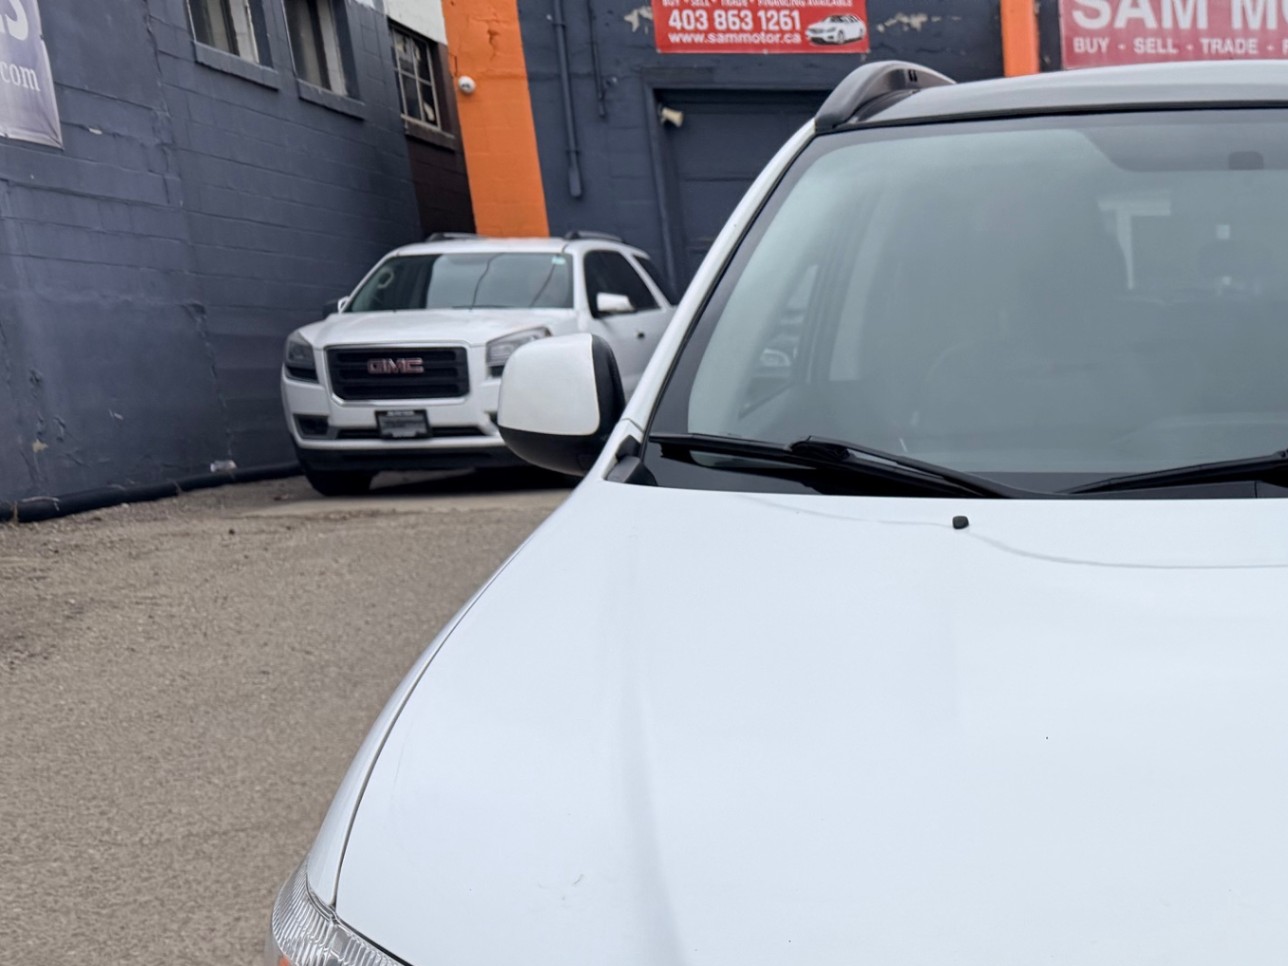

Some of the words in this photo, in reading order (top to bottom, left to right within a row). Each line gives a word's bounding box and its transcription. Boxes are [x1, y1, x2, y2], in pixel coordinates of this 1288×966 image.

[668, 9, 708, 30] 403
[713, 9, 753, 30] 863
[758, 9, 801, 30] 1261
[1072, 0, 1209, 29] SAM
[668, 31, 802, 44] www.sammotor.ca
[1073, 37, 1110, 54] BUY
[1133, 37, 1179, 54] SELL
[1201, 37, 1259, 55] TRADE
[367, 357, 424, 374] GMC
